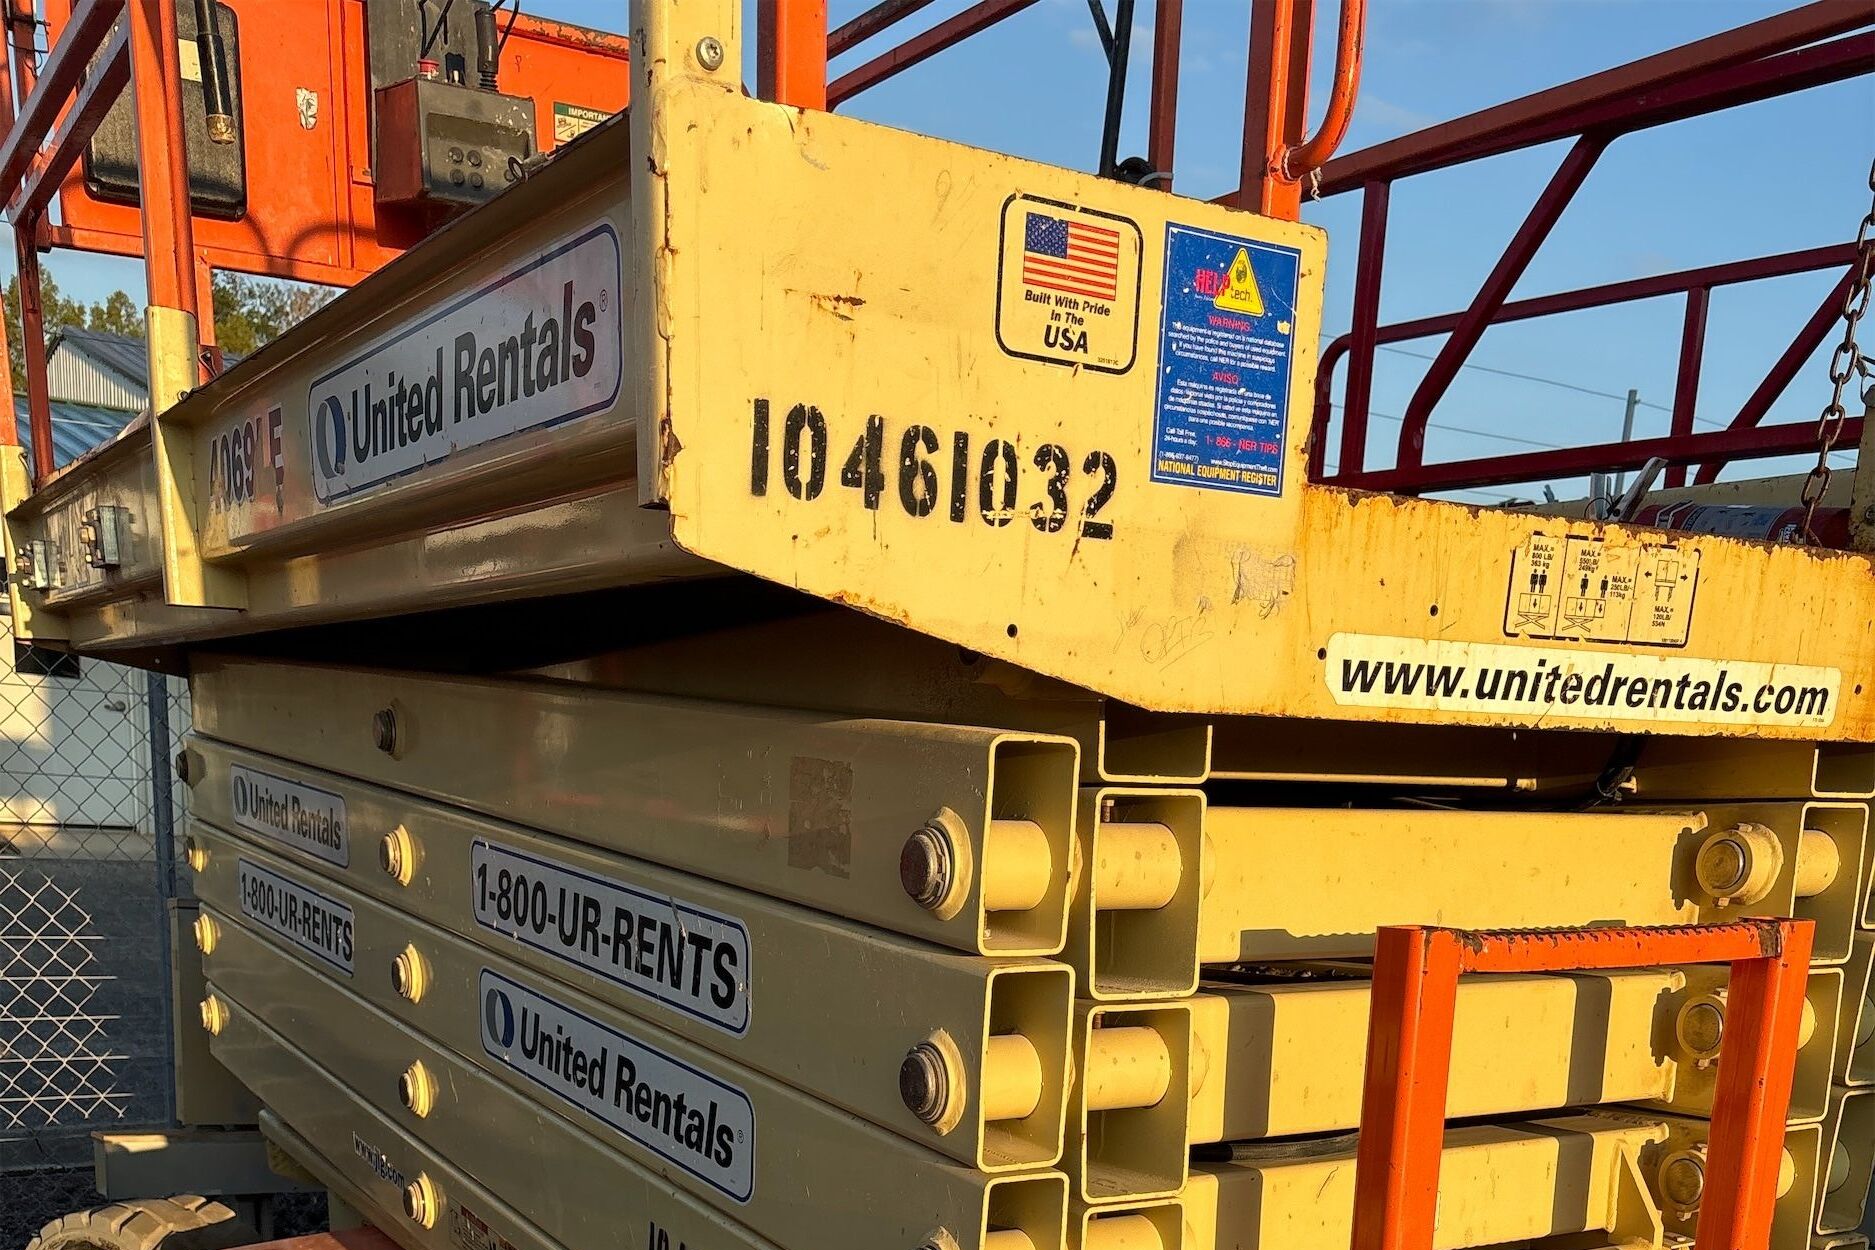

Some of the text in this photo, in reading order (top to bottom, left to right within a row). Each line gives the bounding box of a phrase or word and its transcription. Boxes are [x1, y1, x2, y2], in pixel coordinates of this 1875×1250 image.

[1025, 289, 1111, 316] Built With Pride
[1051, 309, 1084, 326] In The
[352, 280, 596, 464] United Rentals
[1044, 324, 1088, 354] USA
[751, 398, 1117, 540] 10461032
[1158, 459, 1277, 487] NATIONAL EQUIPMENT REGISTER
[1342, 657, 1830, 716] www.unitedrentals.com
[250, 783, 341, 850] United Rentals
[241, 871, 353, 962] 1-800-UR-RENTS
[478, 863, 738, 1010] 1-800-UR-RENTS
[521, 1006, 735, 1169] United Rentals
